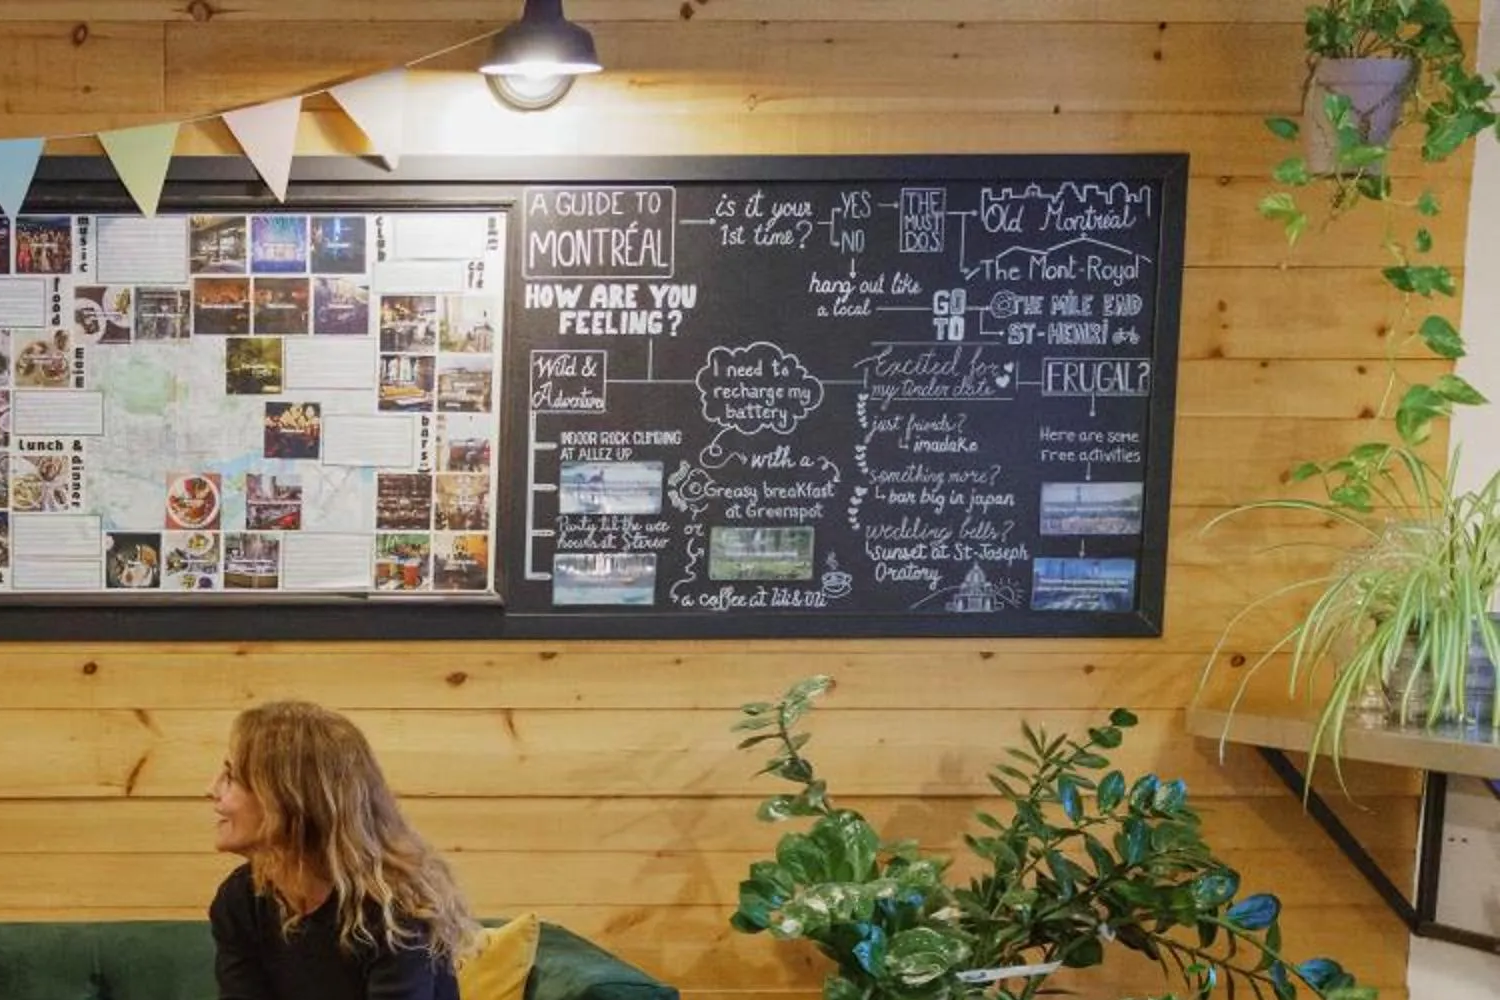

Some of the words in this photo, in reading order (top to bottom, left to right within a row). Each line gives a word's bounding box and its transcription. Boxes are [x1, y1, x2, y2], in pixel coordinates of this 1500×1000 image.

[529, 194, 546, 216] A
[555, 191, 624, 216] GUIDE
[636, 191, 661, 214] TO
[716, 194, 735, 217] is
[745, 189, 764, 217] it
[771, 197, 813, 230] your
[840, 191, 871, 218] YES
[905, 192, 940, 215] THE
[905, 214, 942, 232] MUST
[984, 202, 1022, 232] Old
[1040, 201, 1136, 231] Montréal
[529, 221, 668, 269] MONTRÉAL
[721, 223, 745, 246] 1st
[753, 220, 813, 249] time?
[840, 230, 865, 254] NO
[980, 258, 1020, 280] The
[1029, 254, 1140, 286] Mont-Royal
[525, 284, 583, 308] HOW
[590, 284, 639, 308] ARE
[649, 283, 697, 308] YOU
[809, 271, 851, 302] hang
[860, 277, 884, 294] out
[890, 273, 923, 294] like
[817, 305, 829, 317] a
[832, 299, 871, 316] local
[933, 288, 966, 316] GO
[1012, 294, 1044, 316] THE
[1102, 293, 1143, 317] END
[559, 310, 683, 335] FEELING?
[933, 316, 965, 341] TO
[533, 353, 576, 378] Wild
[581, 355, 598, 377] &
[726, 360, 763, 377] need
[772, 359, 789, 376] to
[875, 345, 962, 377] Excited
[969, 346, 999, 382] for
[1047, 361, 1150, 394] FRUGAL?
[713, 385, 784, 408] recharge
[788, 388, 811, 409] my
[872, 383, 899, 411] my
[952, 375, 996, 397] date
[725, 404, 787, 427] battery
[72, 439, 83, 451] &
[600, 430, 630, 445] ROCK
[1040, 425, 1074, 442] Here
[1078, 430, 1104, 442] are
[1107, 429, 1140, 443] some
[560, 448, 574, 461] AT
[576, 448, 612, 460] ALLEZ
[615, 448, 633, 460] UP
[751, 445, 796, 468] with
[800, 455, 814, 468] a
[1041, 449, 1075, 462] Free
[1078, 447, 1141, 463] activities
[869, 462, 944, 493] something
[704, 480, 759, 503] Greasy
[888, 487, 916, 505] bar
[920, 486, 945, 515] big
[950, 489, 965, 505] in
[965, 488, 1016, 515] japan
[725, 504, 743, 519] at
[746, 502, 824, 522] Greenspot
[931, 543, 950, 560] at
[875, 561, 943, 590] Oratory
[700, 585, 747, 612] coffee
[750, 586, 768, 608] at
